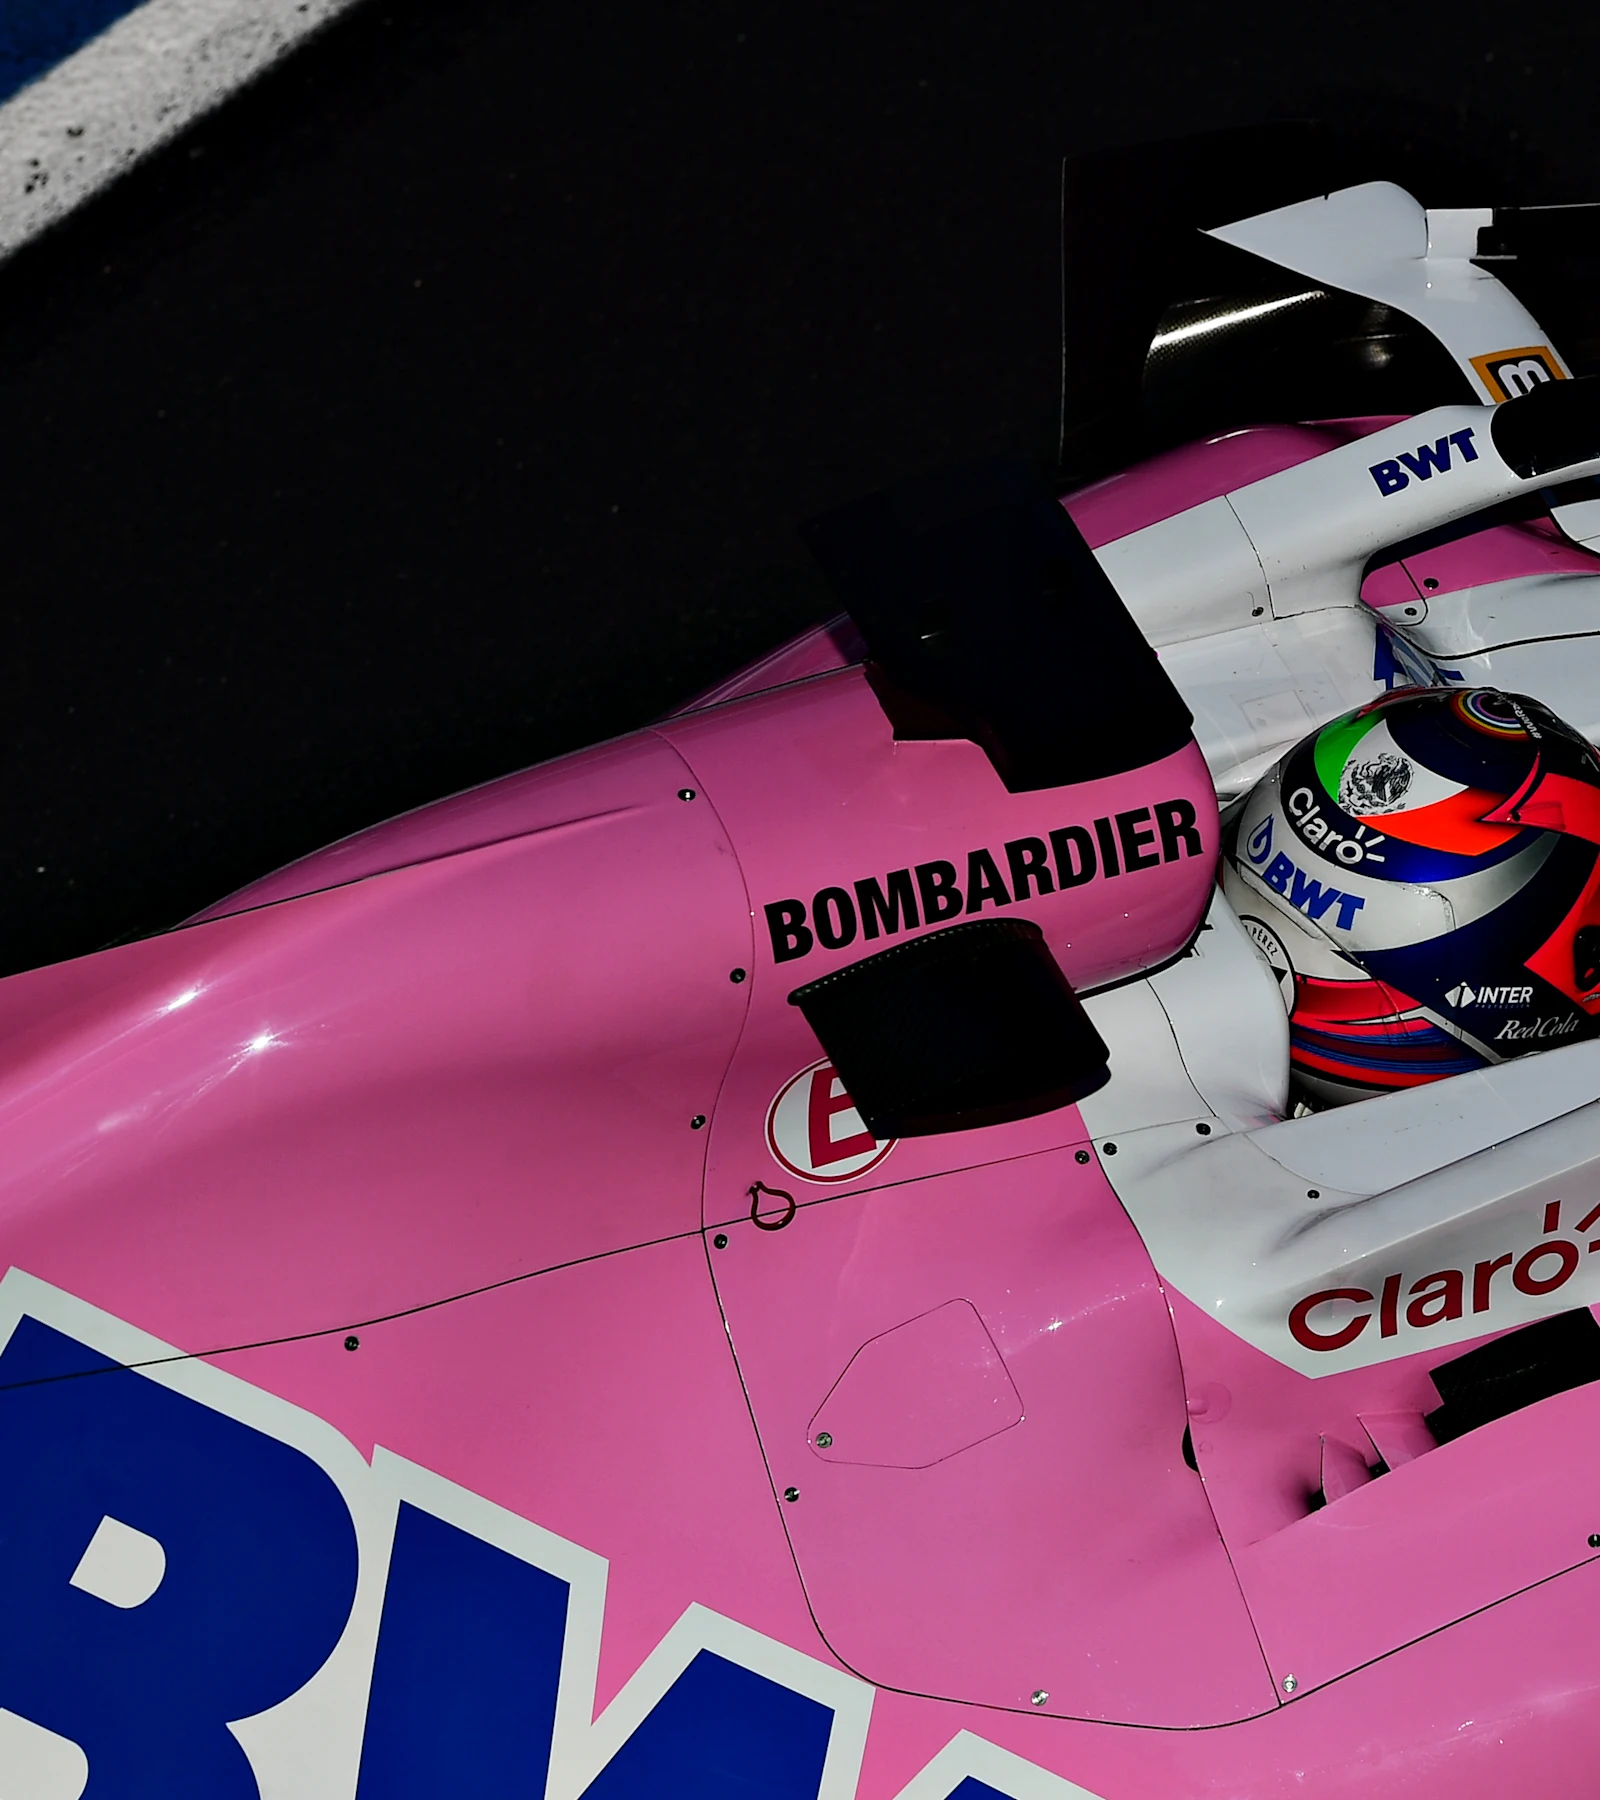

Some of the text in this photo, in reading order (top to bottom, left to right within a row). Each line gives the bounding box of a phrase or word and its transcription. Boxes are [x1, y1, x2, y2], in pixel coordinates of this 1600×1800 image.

[1369, 427, 1478, 497] BWT
[1289, 787, 1364, 865] Claro
[764, 798, 1203, 964] BOMBARDIER
[1261, 850, 1366, 932] BWT
[1476, 986, 1534, 1003] INTER
[1288, 1239, 1579, 1352] Claro
